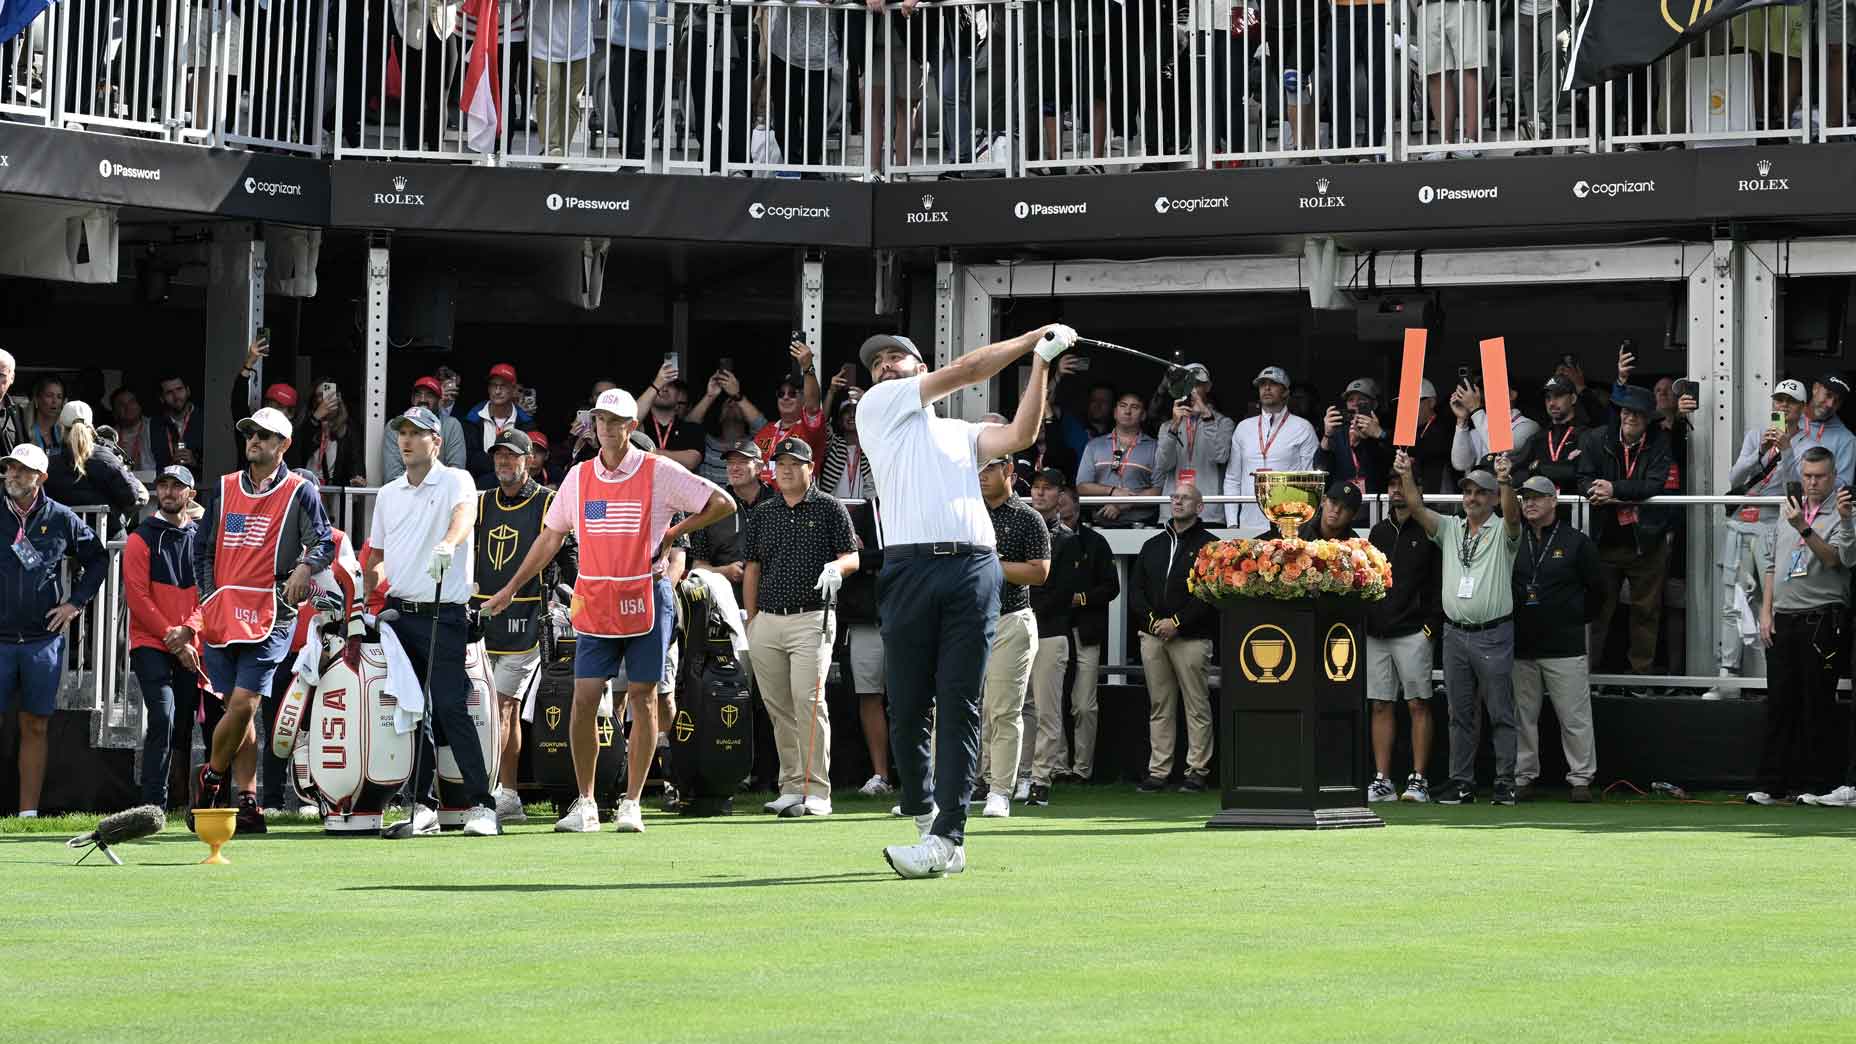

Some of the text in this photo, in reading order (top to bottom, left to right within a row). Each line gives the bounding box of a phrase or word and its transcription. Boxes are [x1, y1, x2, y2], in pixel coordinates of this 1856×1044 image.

[112, 164, 161, 182] 1Password
[257, 179, 302, 196] cognizant
[1436, 185, 1498, 200] 1Password
[1592, 180, 1656, 197] cognizant
[1738, 177, 1790, 192] ROLEX
[373, 191, 425, 206] ROLEX
[564, 197, 630, 211] 1Password
[1172, 195, 1229, 213] cognizant
[1299, 196, 1345, 209] ROLEX
[767, 203, 831, 220] cognizant
[906, 210, 949, 223] ROLEX
[1031, 201, 1087, 216] 1Password
[619, 597, 646, 616] USA
[234, 608, 258, 624] USA
[507, 618, 528, 633] INT
[276, 705, 299, 737] USA
[322, 688, 347, 770] USA
